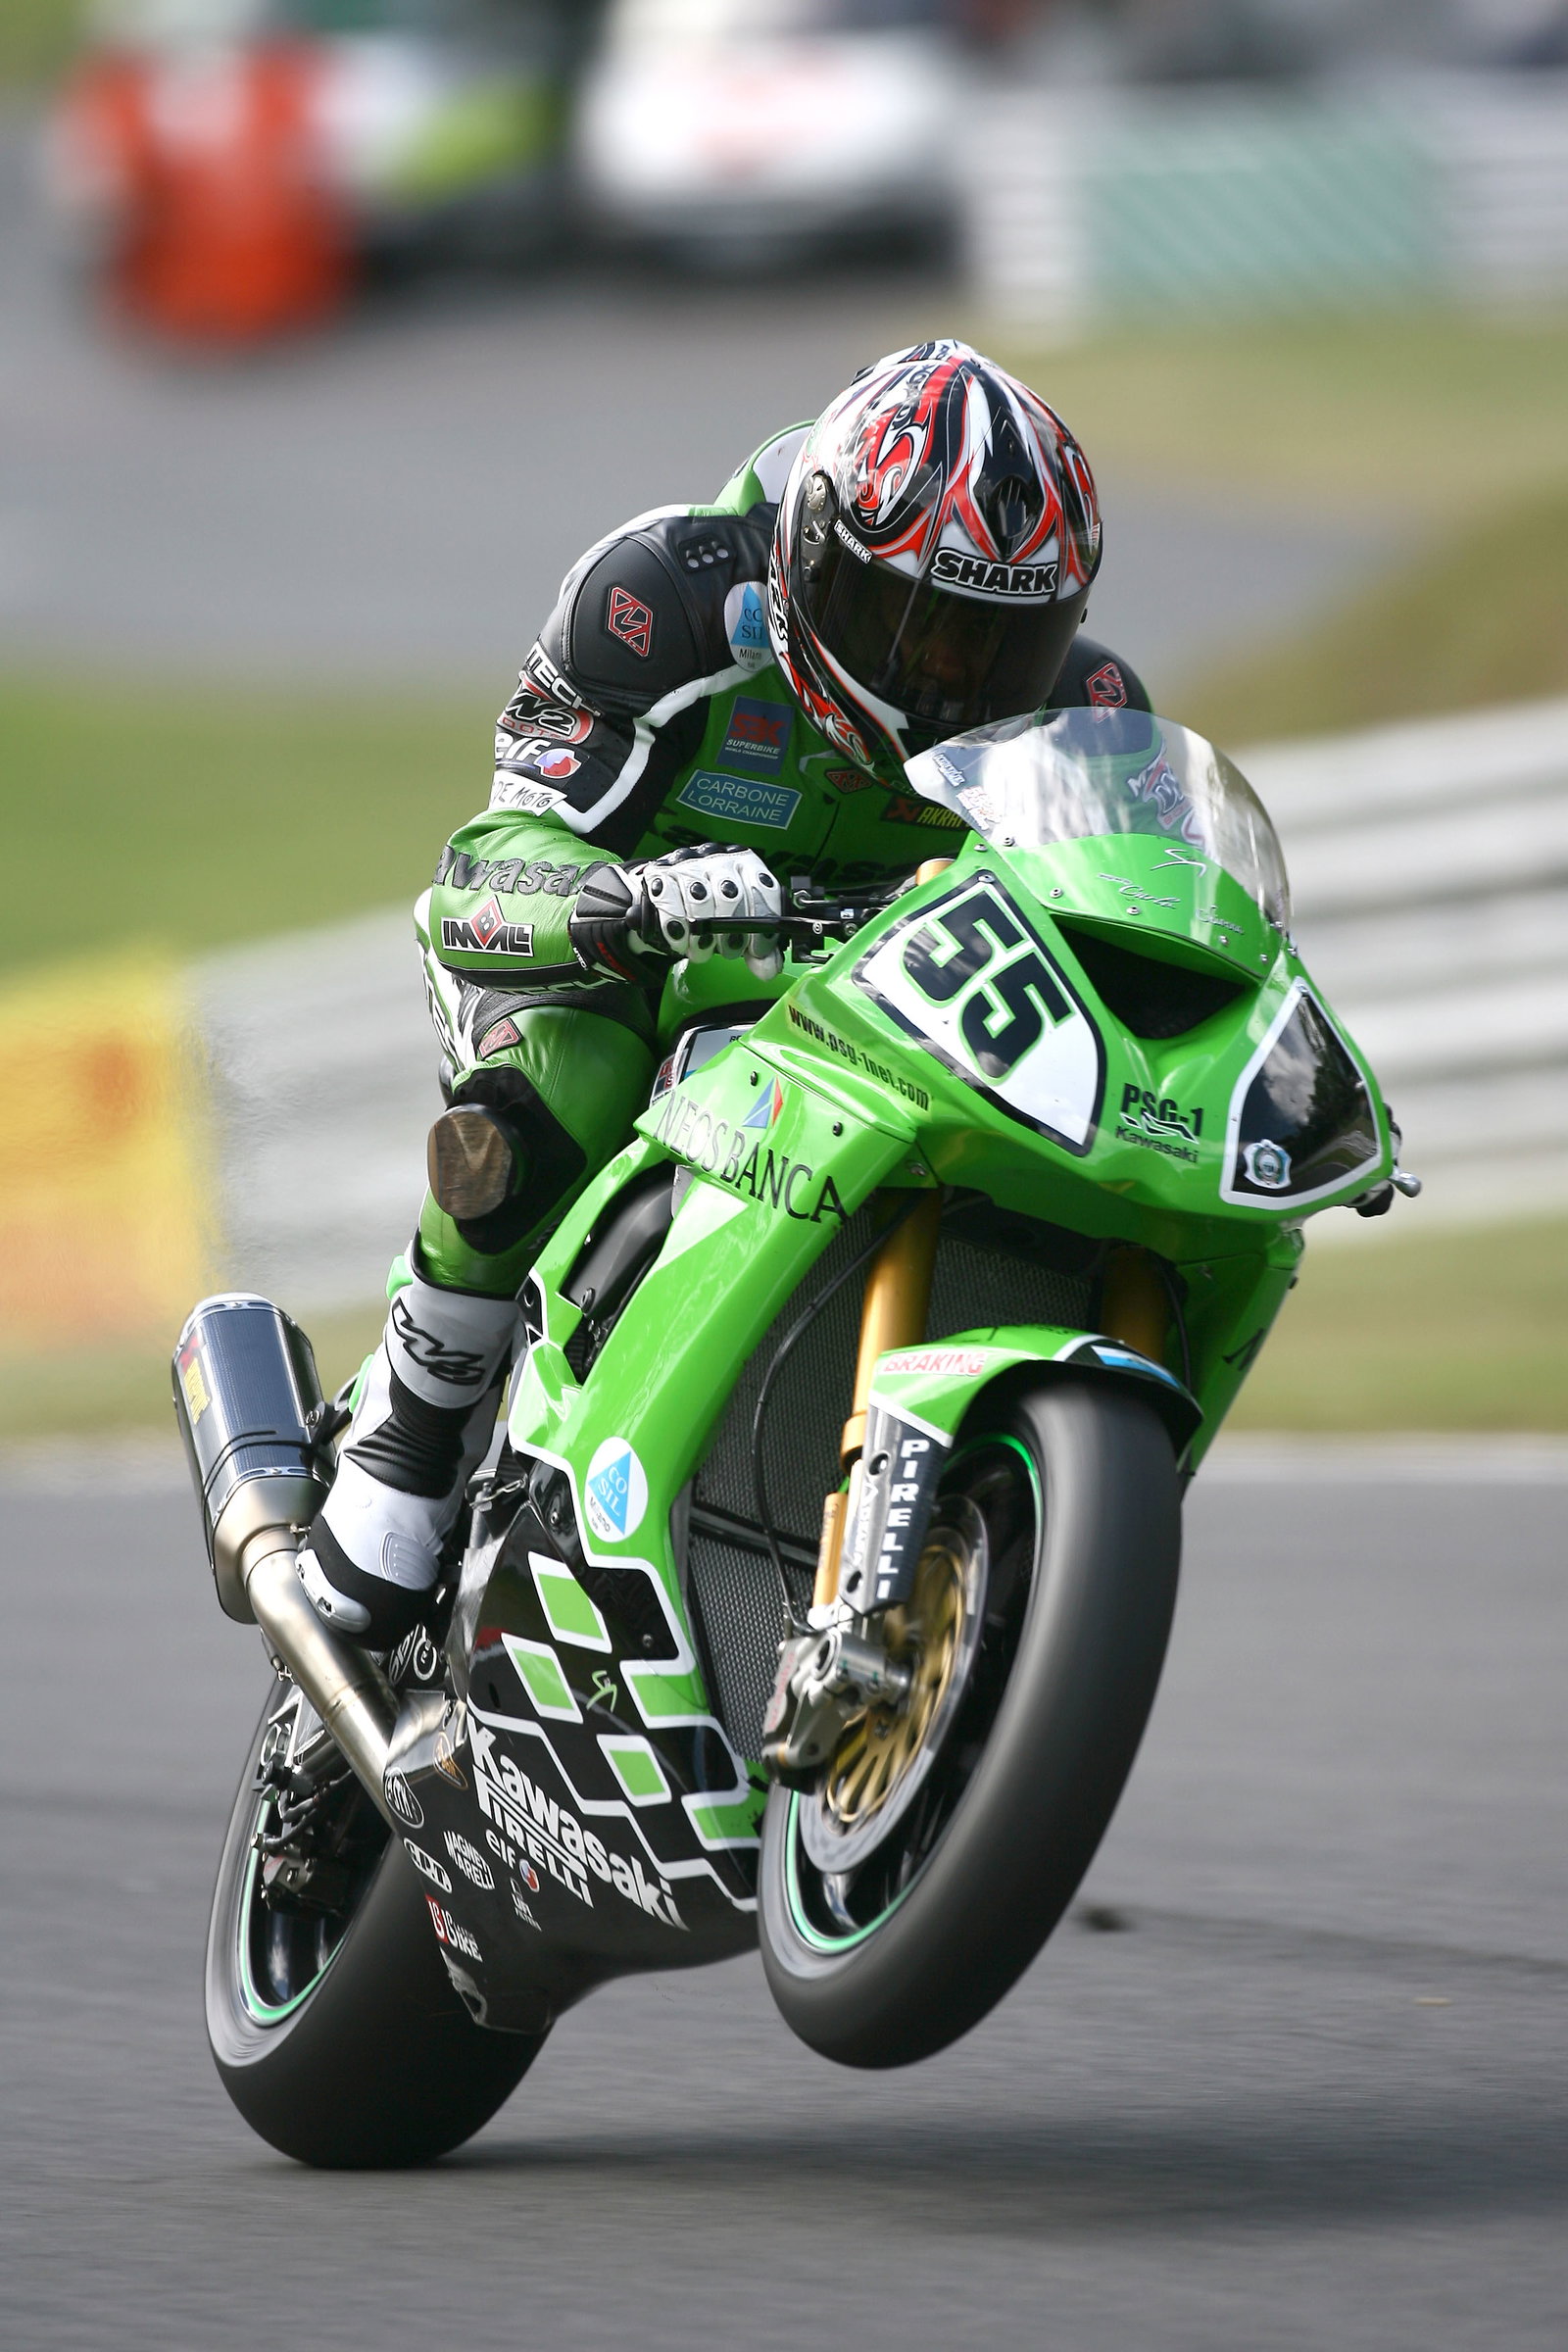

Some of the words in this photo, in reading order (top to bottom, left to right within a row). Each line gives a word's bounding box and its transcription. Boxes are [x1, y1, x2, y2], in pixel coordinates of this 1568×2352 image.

[834, 519, 873, 564] SHARK
[930, 547, 1058, 597] SHARK
[726, 739, 781, 755] SUPERBIKE
[729, 712, 785, 747] SBK
[687, 790, 783, 821] LORRAINE
[697, 778, 790, 807] CARBONE
[902, 887, 1075, 1085] 55
[788, 1004, 931, 1111] www.psg-1net.com
[1121, 1083, 1204, 1137] PSG-1
[653, 1090, 728, 1172] NEOS
[720, 1129, 850, 1224] BANCA
[1115, 1125, 1200, 1164] Kawasaki
[884, 1353, 985, 1374] BRAKING
[598, 1478, 620, 1517] SIL
[608, 1466, 627, 1494] CO
[876, 1439, 931, 1599] PIRELLI
[466, 1710, 690, 1933] Kawasaki
[472, 1763, 595, 1909] PIRELLI
[485, 1829, 516, 1870] elf
